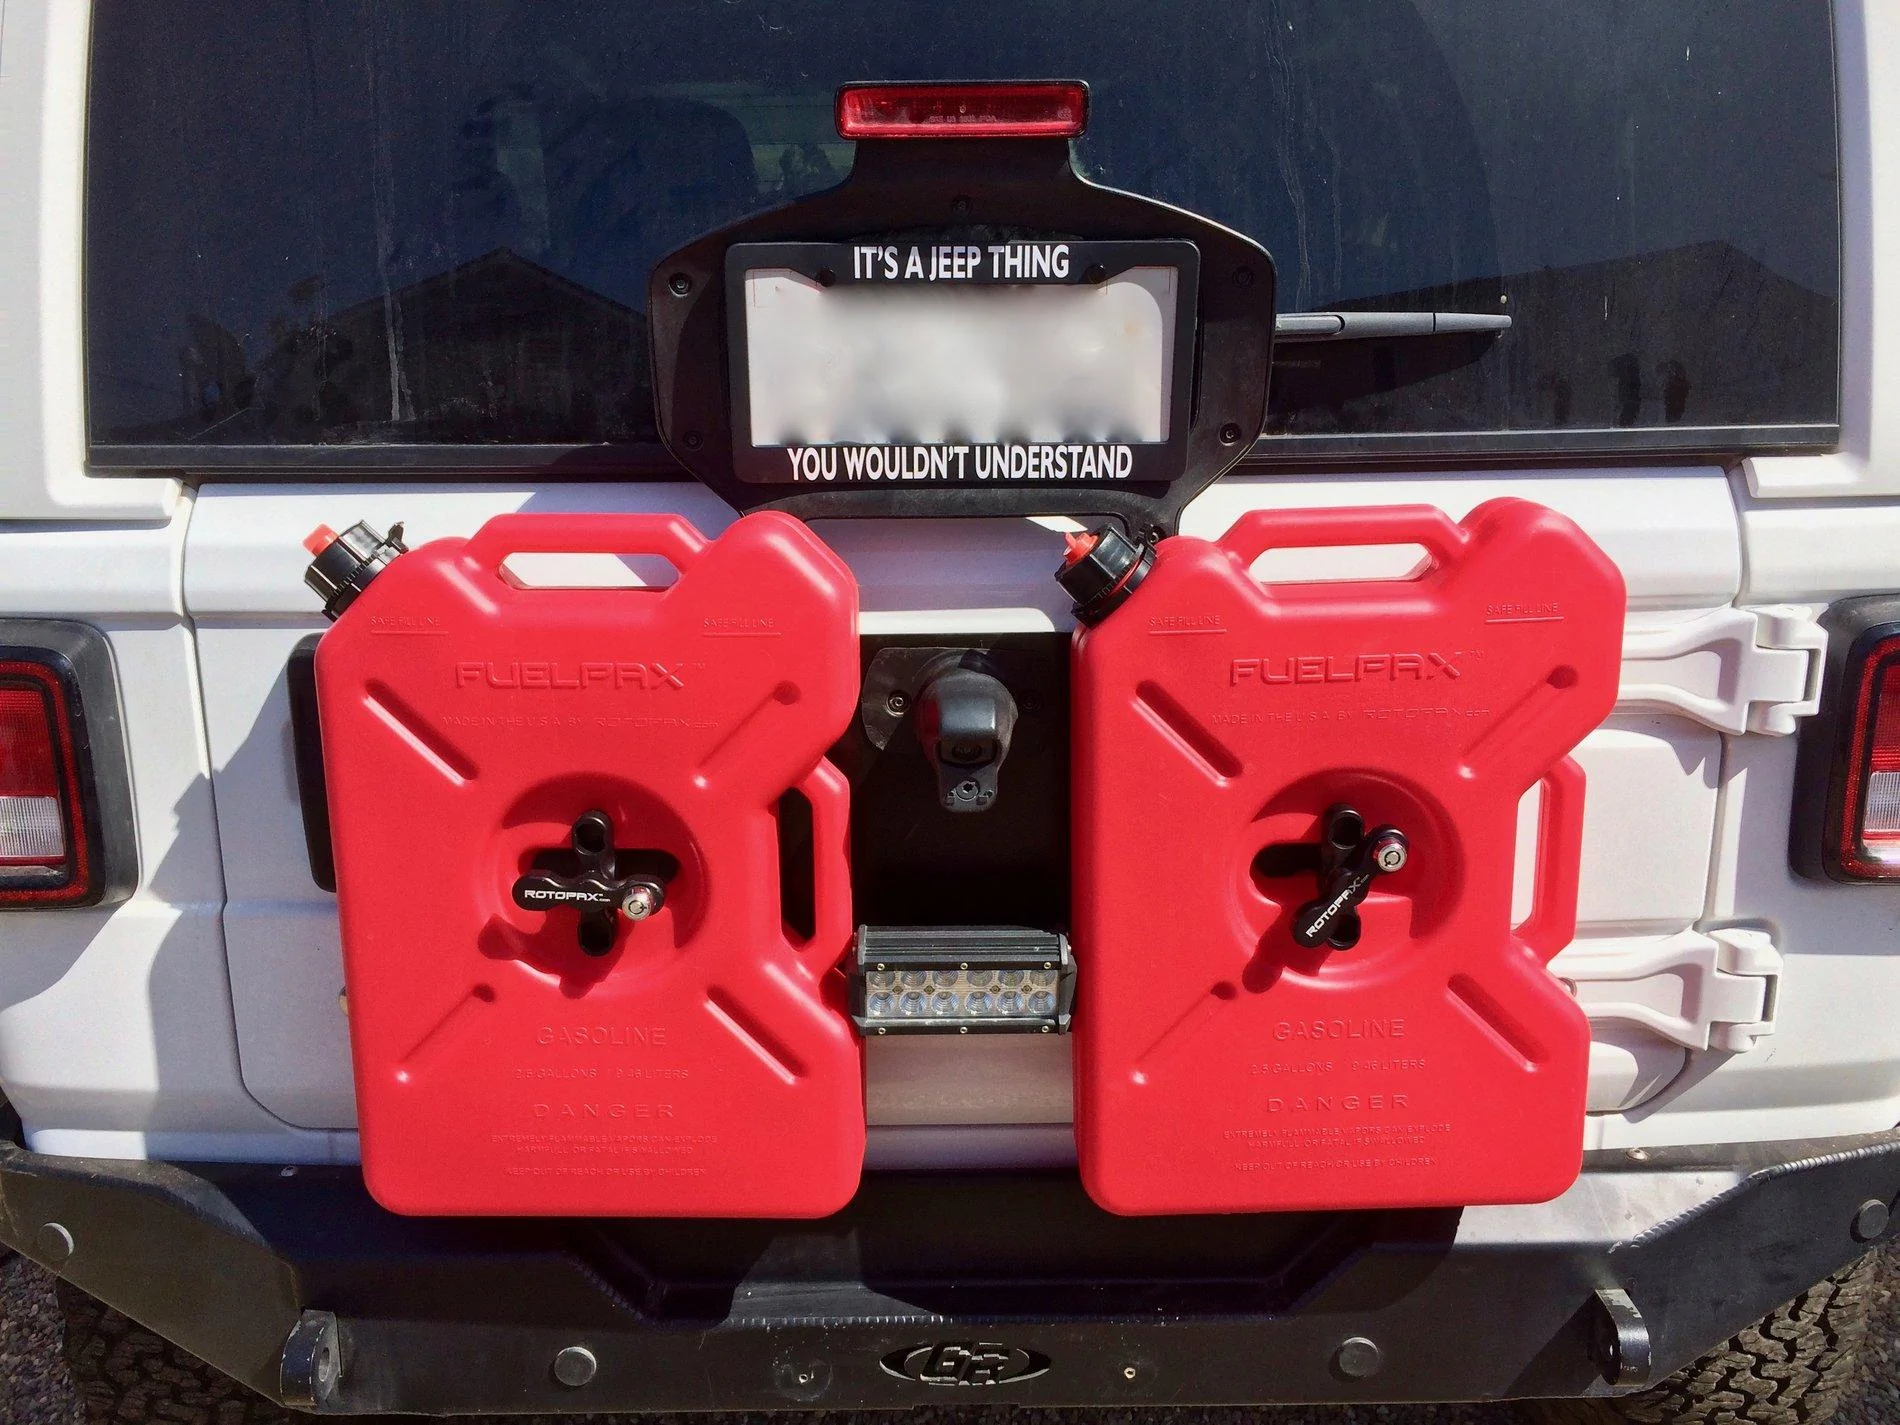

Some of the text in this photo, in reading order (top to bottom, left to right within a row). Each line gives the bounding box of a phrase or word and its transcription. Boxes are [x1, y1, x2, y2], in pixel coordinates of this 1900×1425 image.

[853, 244, 1069, 282] IT'S A JEEP THING
[787, 445, 1132, 481] YOU WOULDN'T UNDERSTAND
[455, 662, 685, 689] FUELPAX
[1230, 652, 1463, 687] FUELPAX
[537, 1026, 668, 1046] GASOLINE
[1273, 1019, 1406, 1041] GASOLINE
[533, 1103, 675, 1119] DANGER
[1267, 1094, 1409, 1112] DANGER
